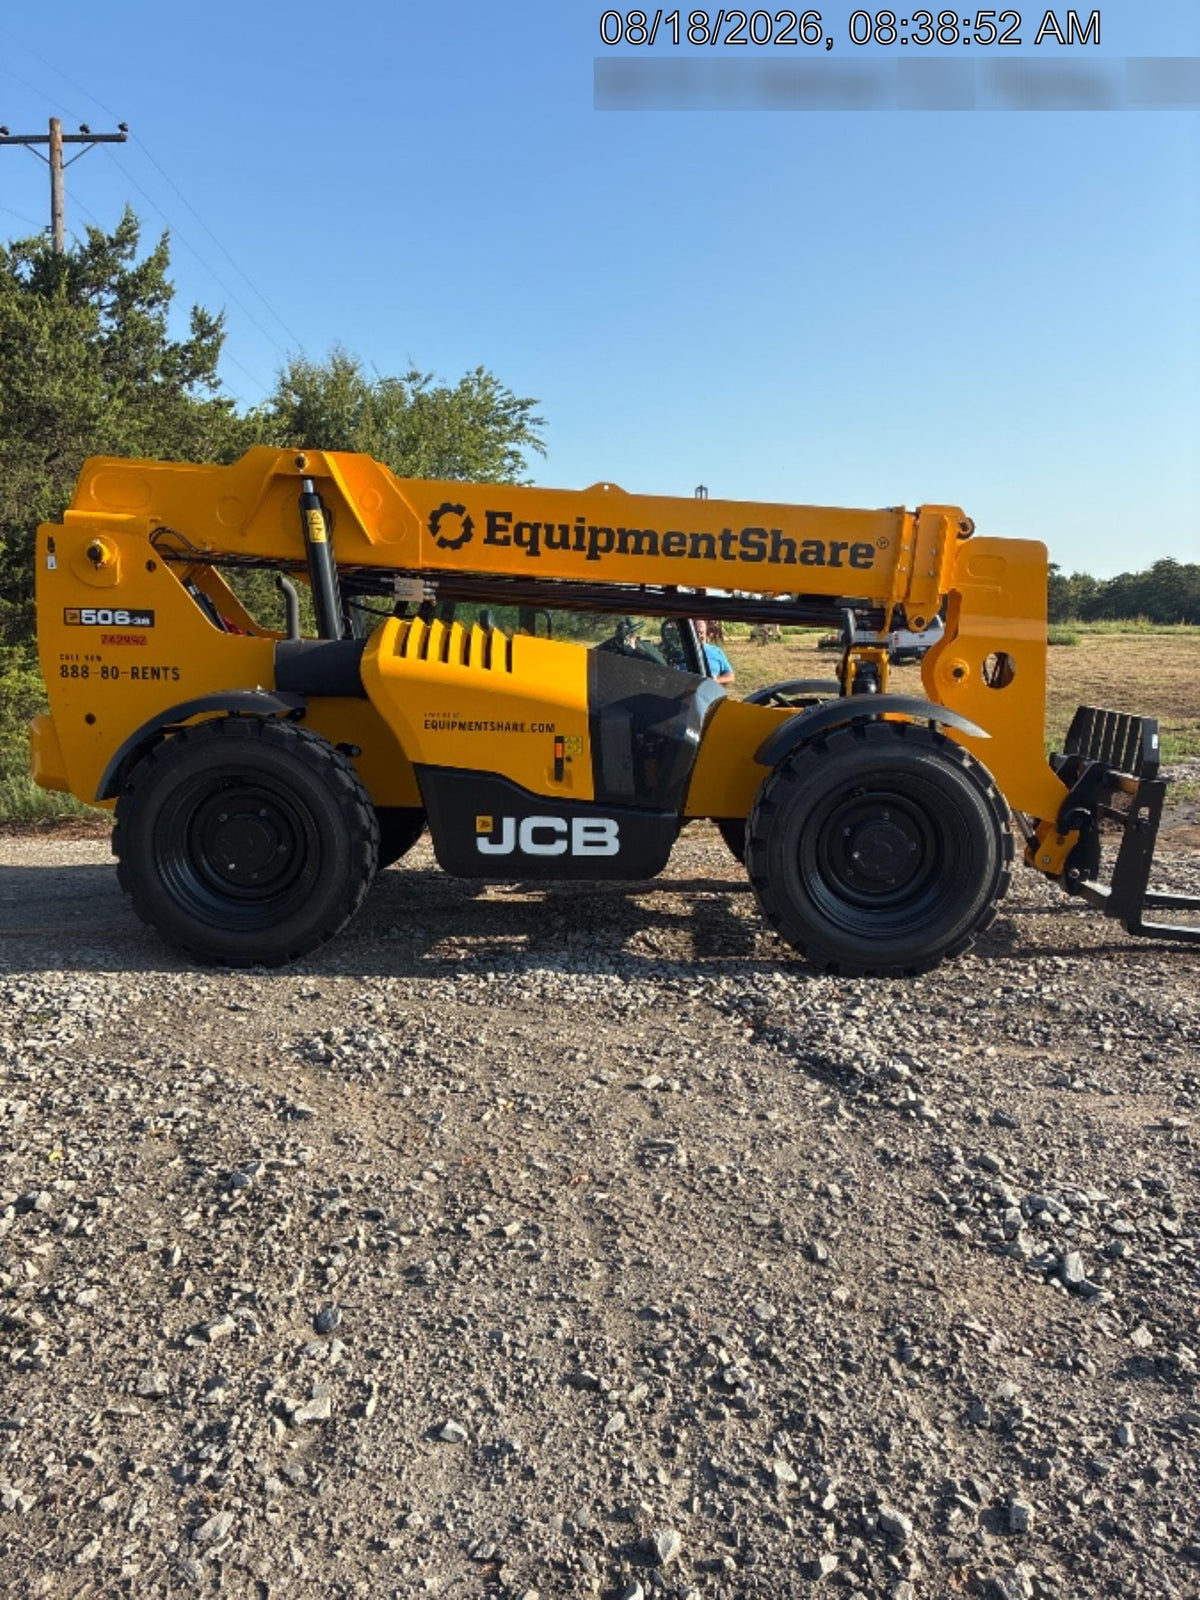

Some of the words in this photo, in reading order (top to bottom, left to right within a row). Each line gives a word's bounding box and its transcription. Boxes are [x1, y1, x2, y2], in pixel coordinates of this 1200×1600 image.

[484, 510, 875, 569] EquipmentShare
[60, 664, 181, 681] 888-80-RENTS
[424, 719, 556, 733] EQUIPMENTSHARE.COM
[476, 816, 620, 856] JCB
